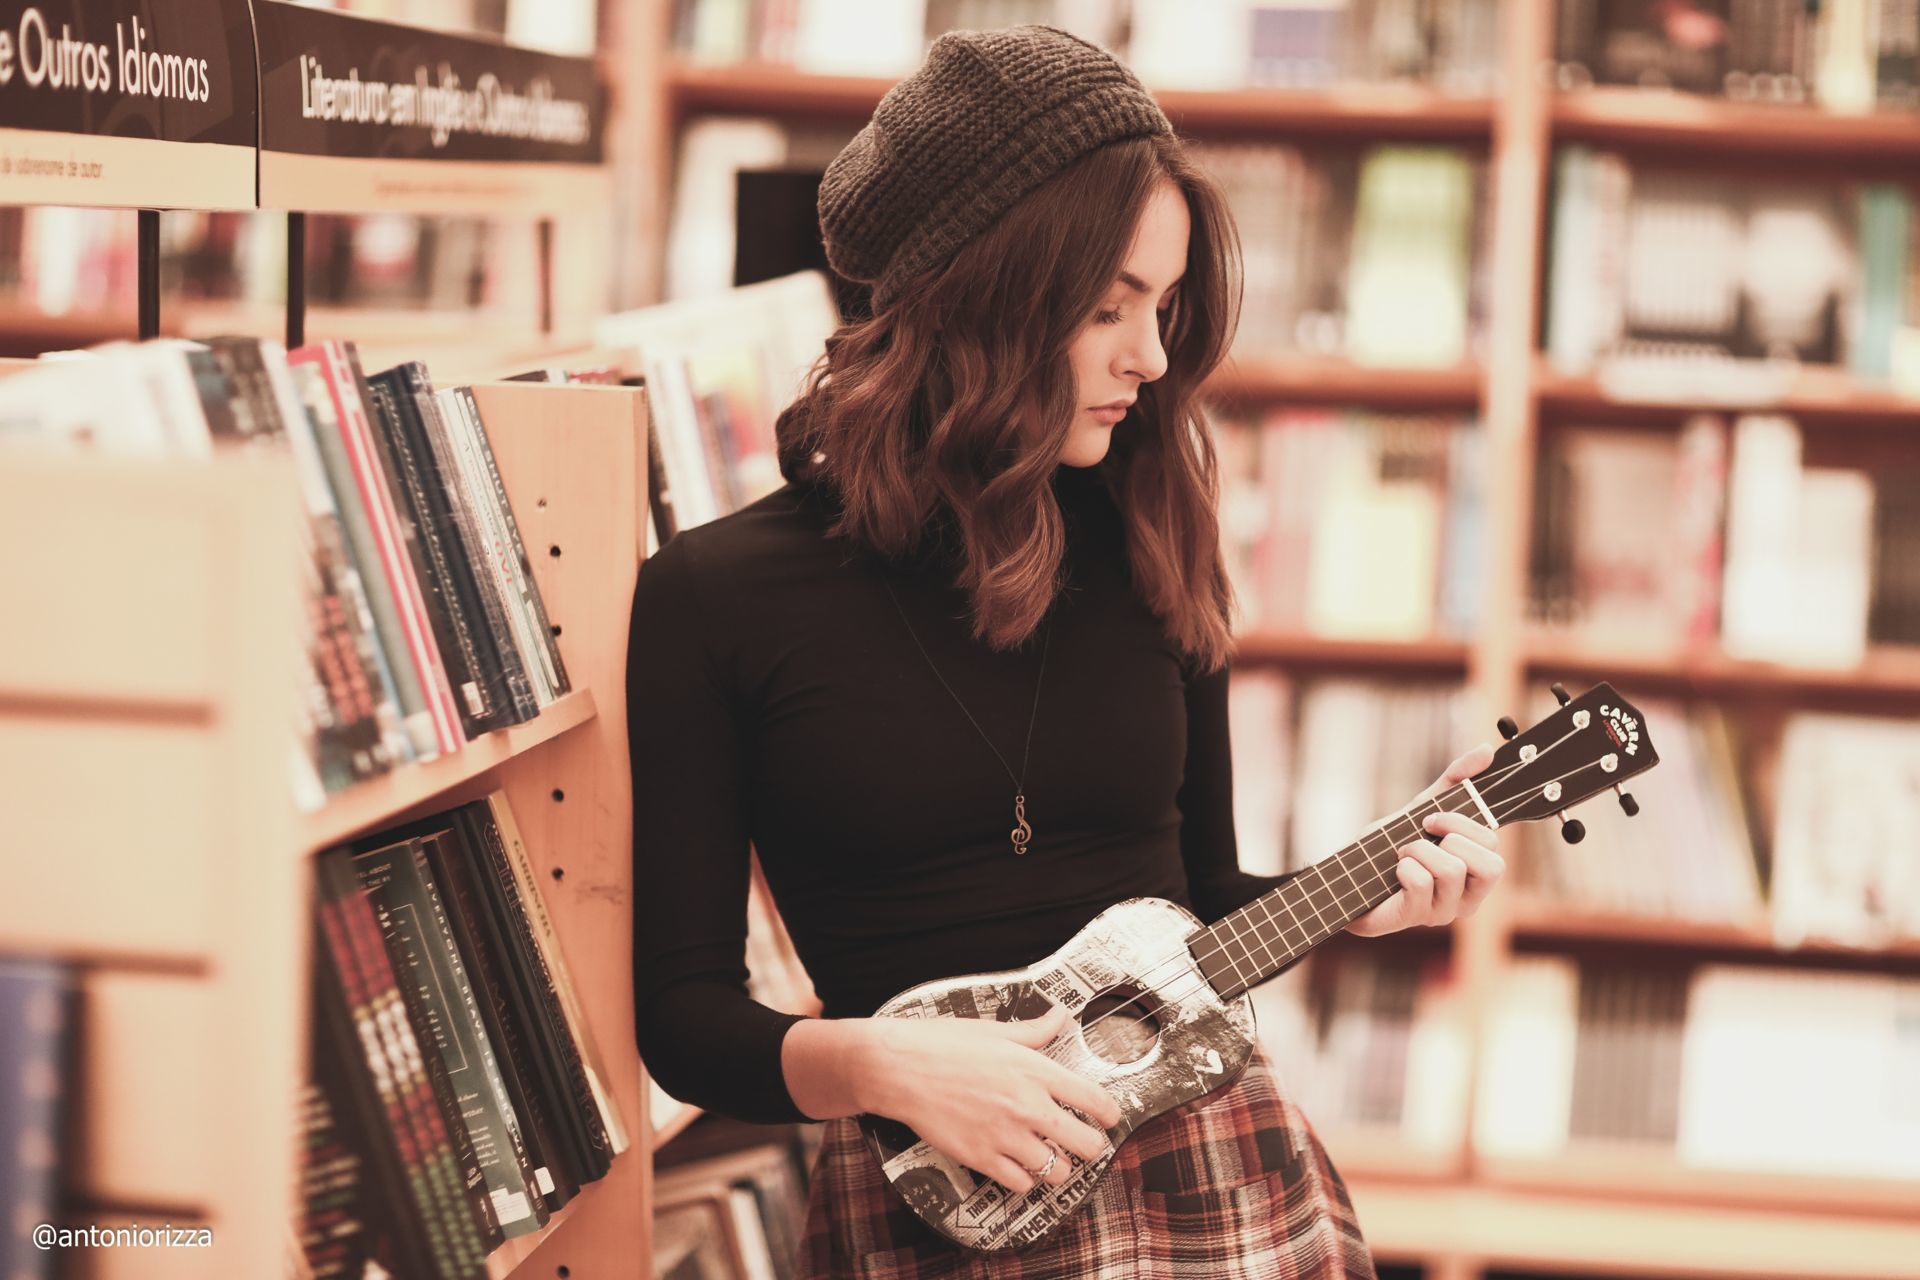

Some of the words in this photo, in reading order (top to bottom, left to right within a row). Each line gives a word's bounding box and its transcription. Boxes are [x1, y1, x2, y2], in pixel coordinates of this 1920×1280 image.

[0, 29, 15, 85] e
[18, 7, 111, 92] Outros
[116, 15, 210, 103] Idiomas
[300, 54, 391, 125] Literatura
[485, 449, 507, 507] SHUT
[1610, 718, 1628, 743] CLUB
[426, 882, 463, 975] EVERYONE
[461, 985, 485, 1040] BRAVE
[1046, 979, 1071, 996] PLAYED
[1055, 986, 1072, 999] HERE
[1060, 989, 1081, 1005] 282
[1067, 996, 1086, 1010] TIMES
[965, 1197, 987, 1219] THIS
[984, 1189, 998, 1203] IS
